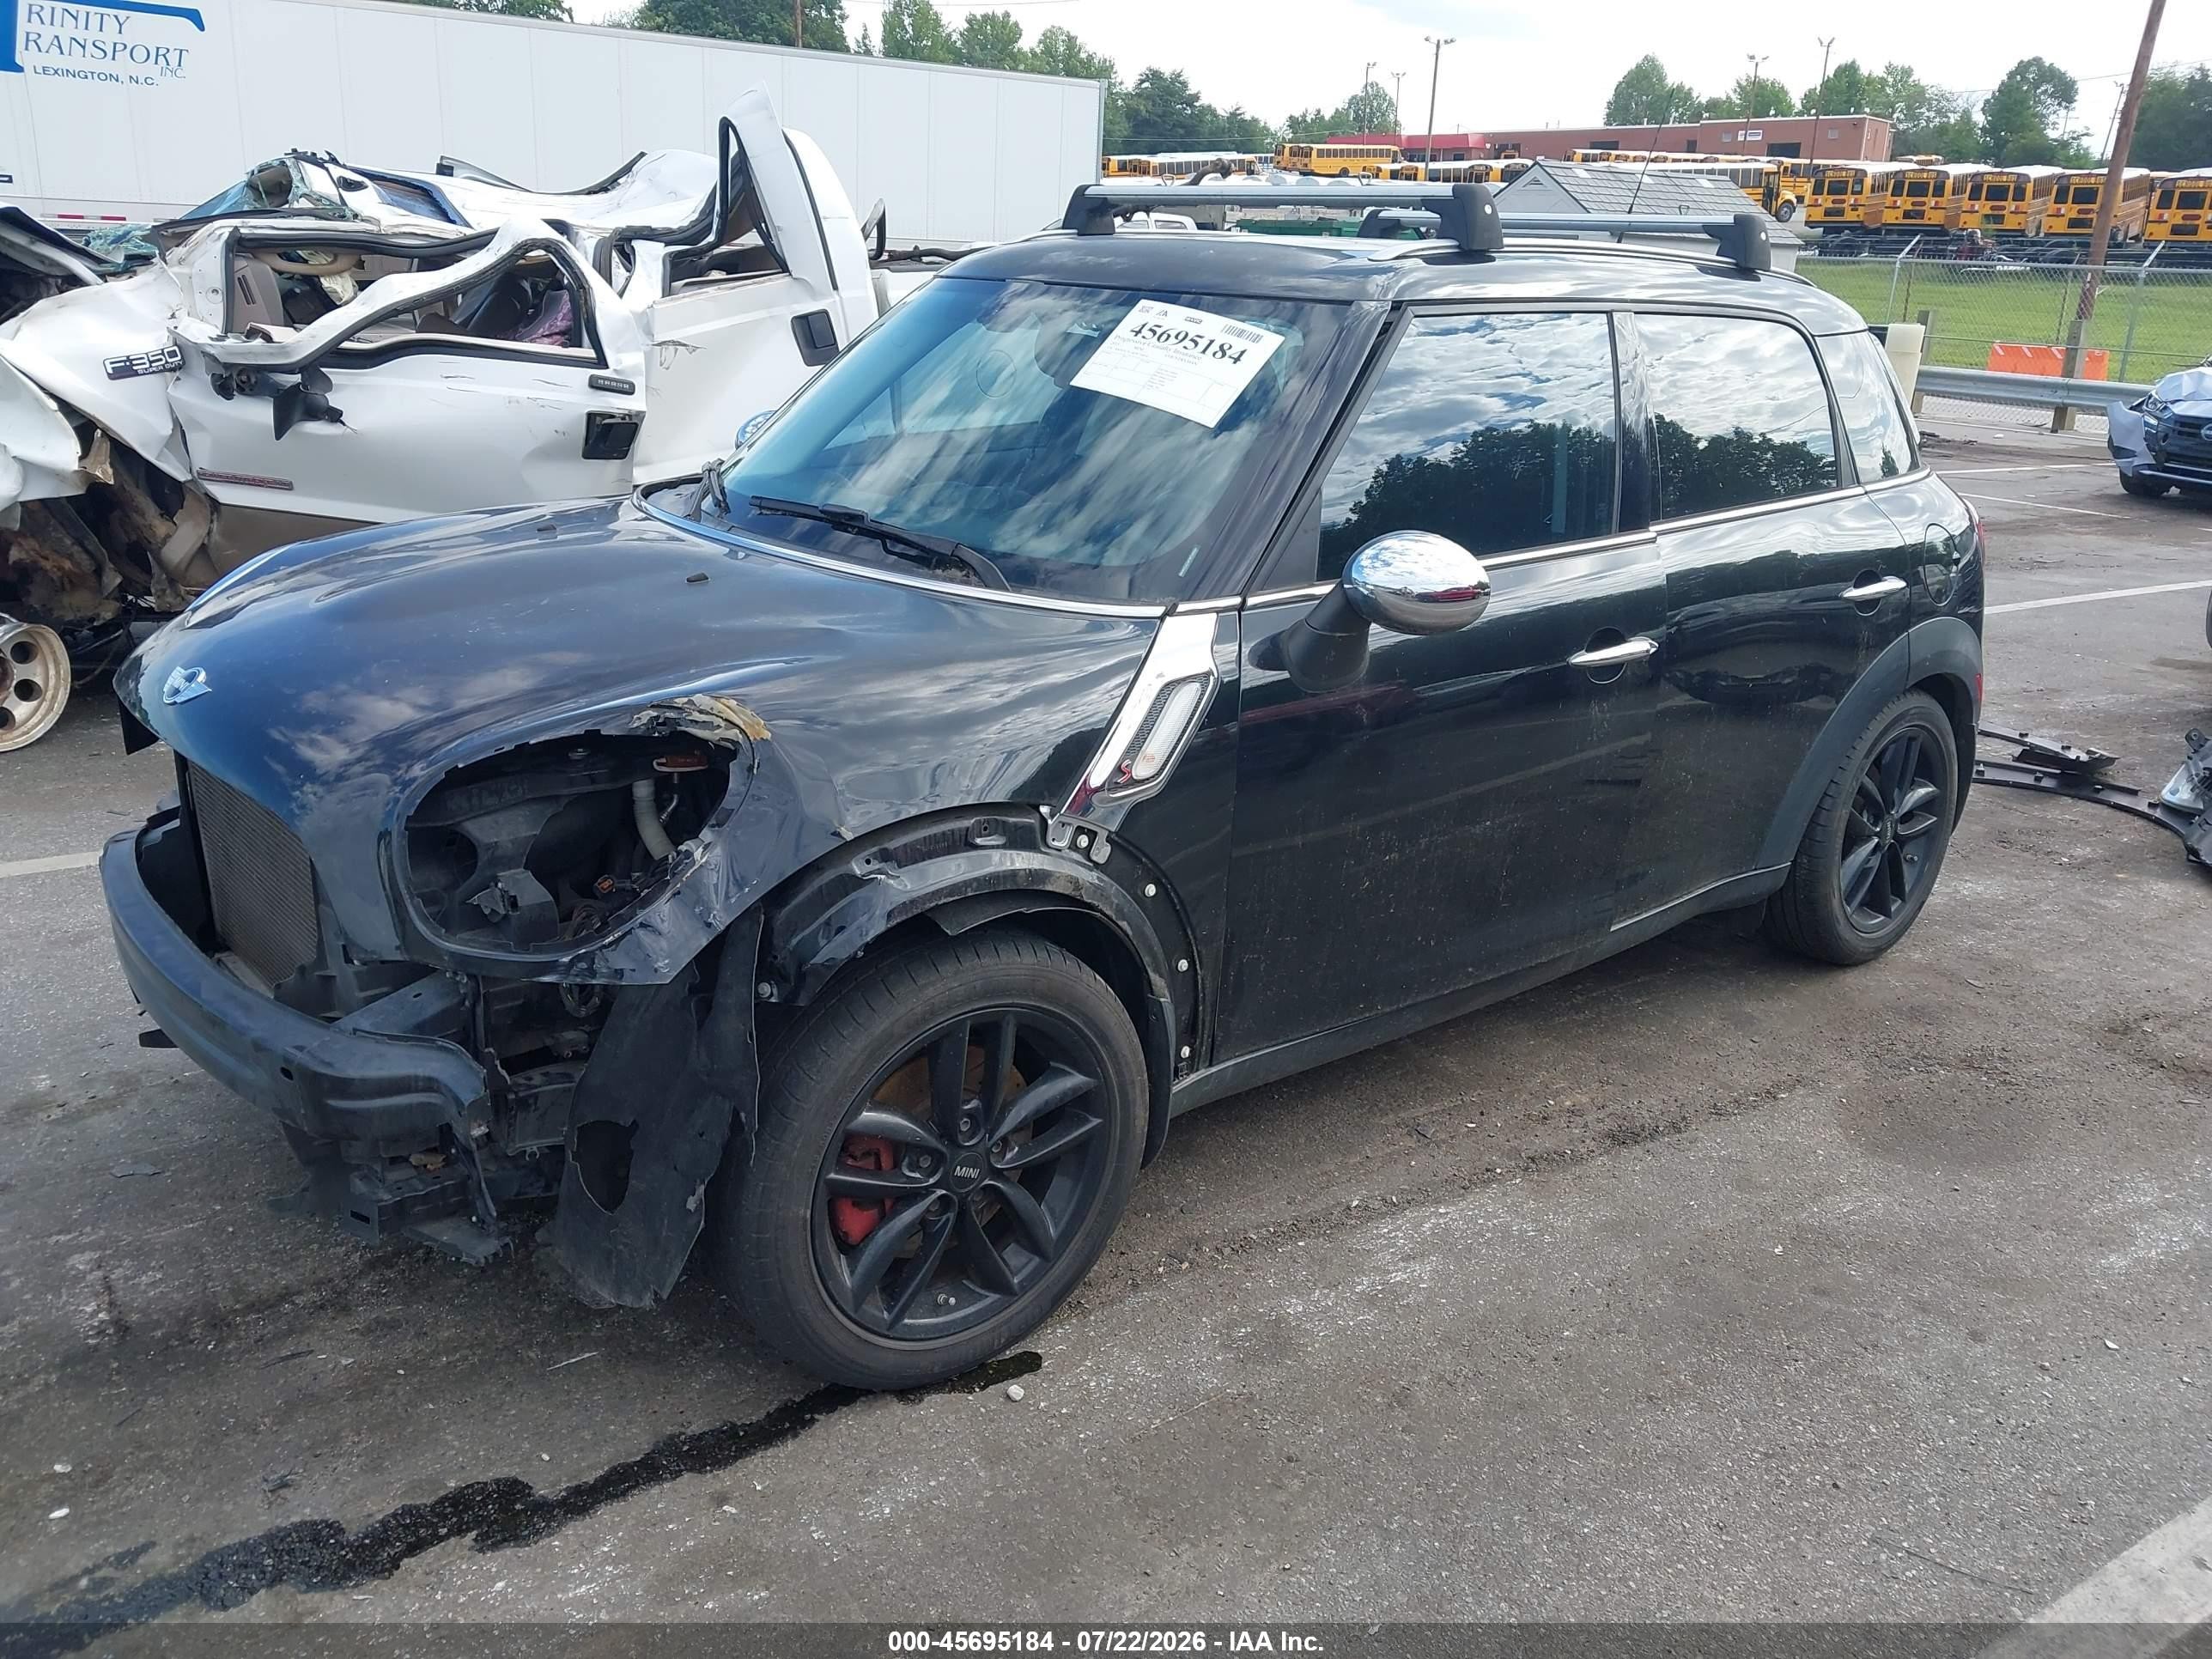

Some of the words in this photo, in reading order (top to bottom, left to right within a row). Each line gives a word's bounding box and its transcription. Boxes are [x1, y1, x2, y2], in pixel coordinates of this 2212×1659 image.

[33, 64, 125, 84] LEXINGTON,
[129, 75, 159, 86] N.C.
[160, 66, 186, 79] INC.
[1130, 321, 1248, 365] 45695184
[137, 365, 164, 374] SUPER
[165, 360, 183, 369] DUTY
[954, 1165, 980, 1179] MINI
